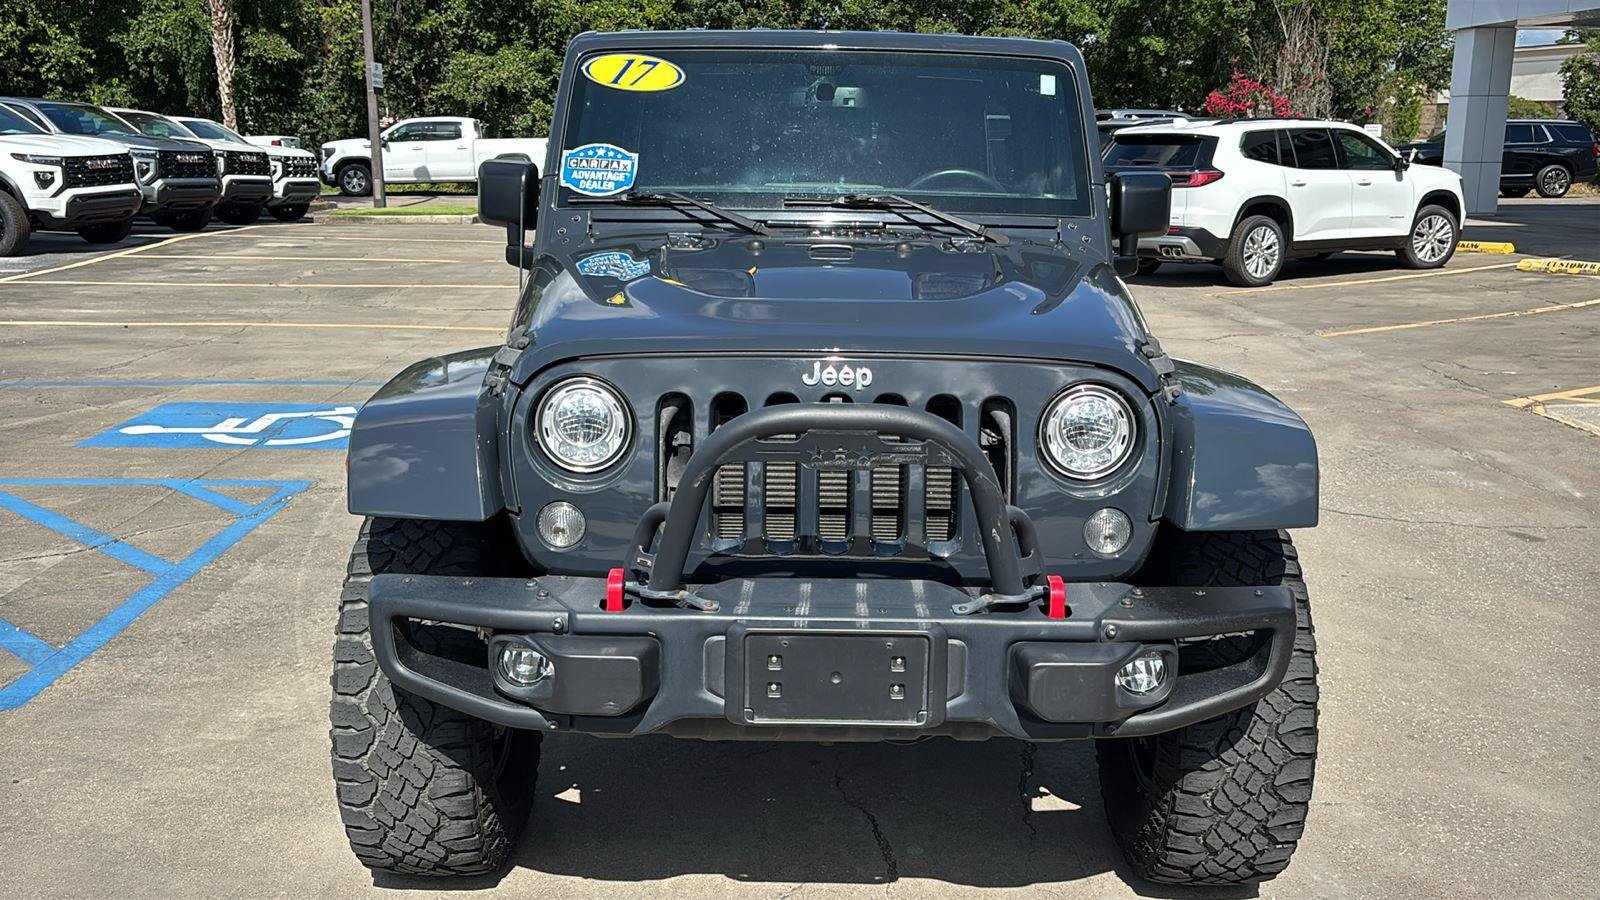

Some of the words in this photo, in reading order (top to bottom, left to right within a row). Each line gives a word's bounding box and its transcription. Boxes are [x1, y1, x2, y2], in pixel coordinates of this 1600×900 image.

[607, 58, 661, 87] 17
[568, 158, 631, 172] CARFAX
[571, 170, 626, 182] ADVANTAGE
[579, 180, 616, 190] DEALER
[1546, 261, 1597, 269] CUSTOMER
[802, 361, 873, 391] Jeep
